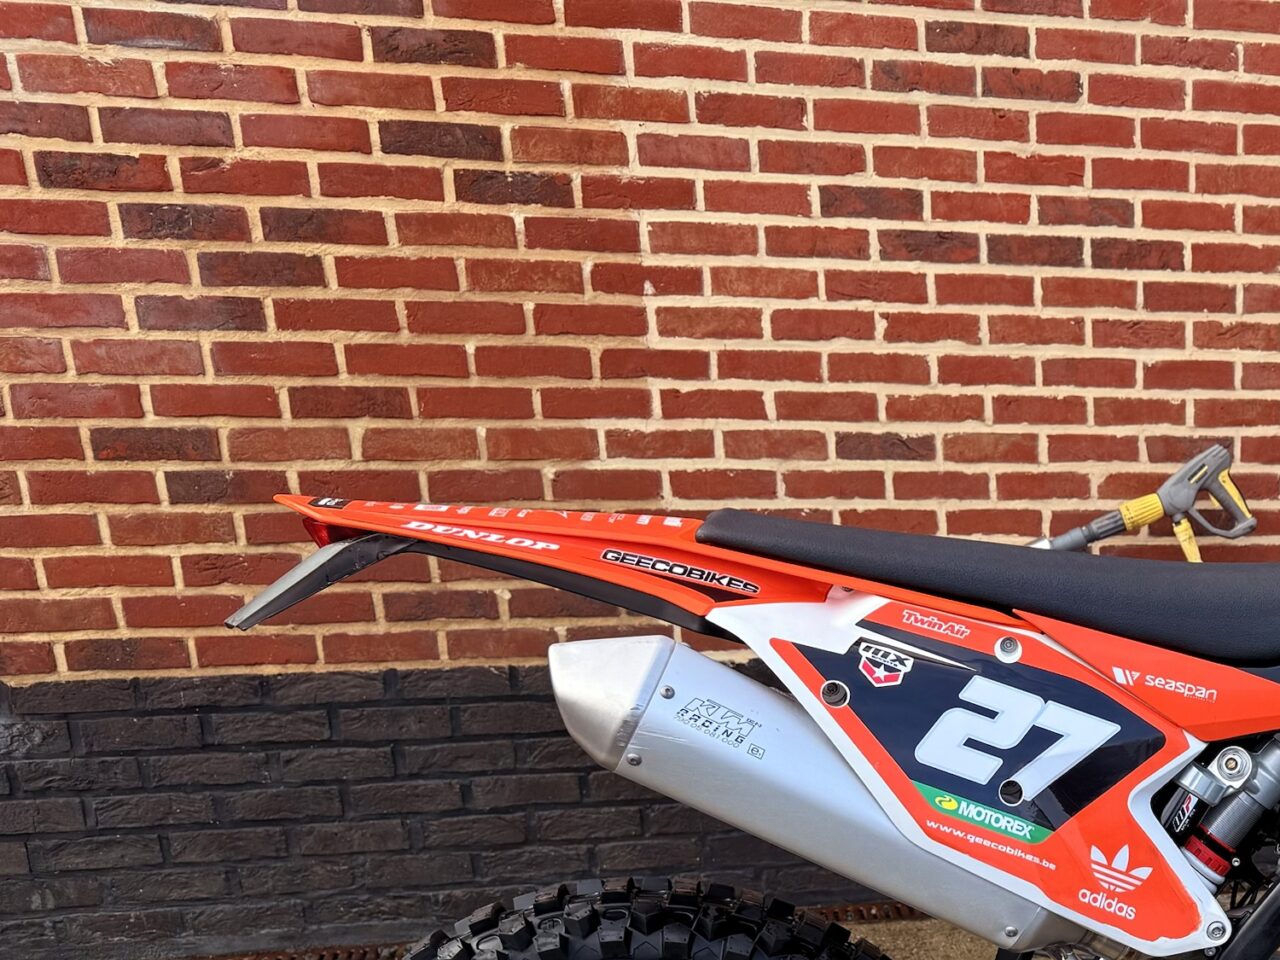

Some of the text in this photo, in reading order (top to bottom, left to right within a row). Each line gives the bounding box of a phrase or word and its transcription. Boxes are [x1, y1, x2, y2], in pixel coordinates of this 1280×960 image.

[401, 520, 561, 551] DUNLOP
[601, 547, 761, 594] GEECOBIKES
[1144, 674, 1218, 701] seaspan
[676, 707, 747, 745] RACING
[683, 696, 755, 738] KTM
[913, 673, 1122, 804] 27
[958, 800, 1034, 840] MOTOREX
[926, 819, 1057, 871] www.geecobikes.be
[1078, 887, 1137, 921] adidas
